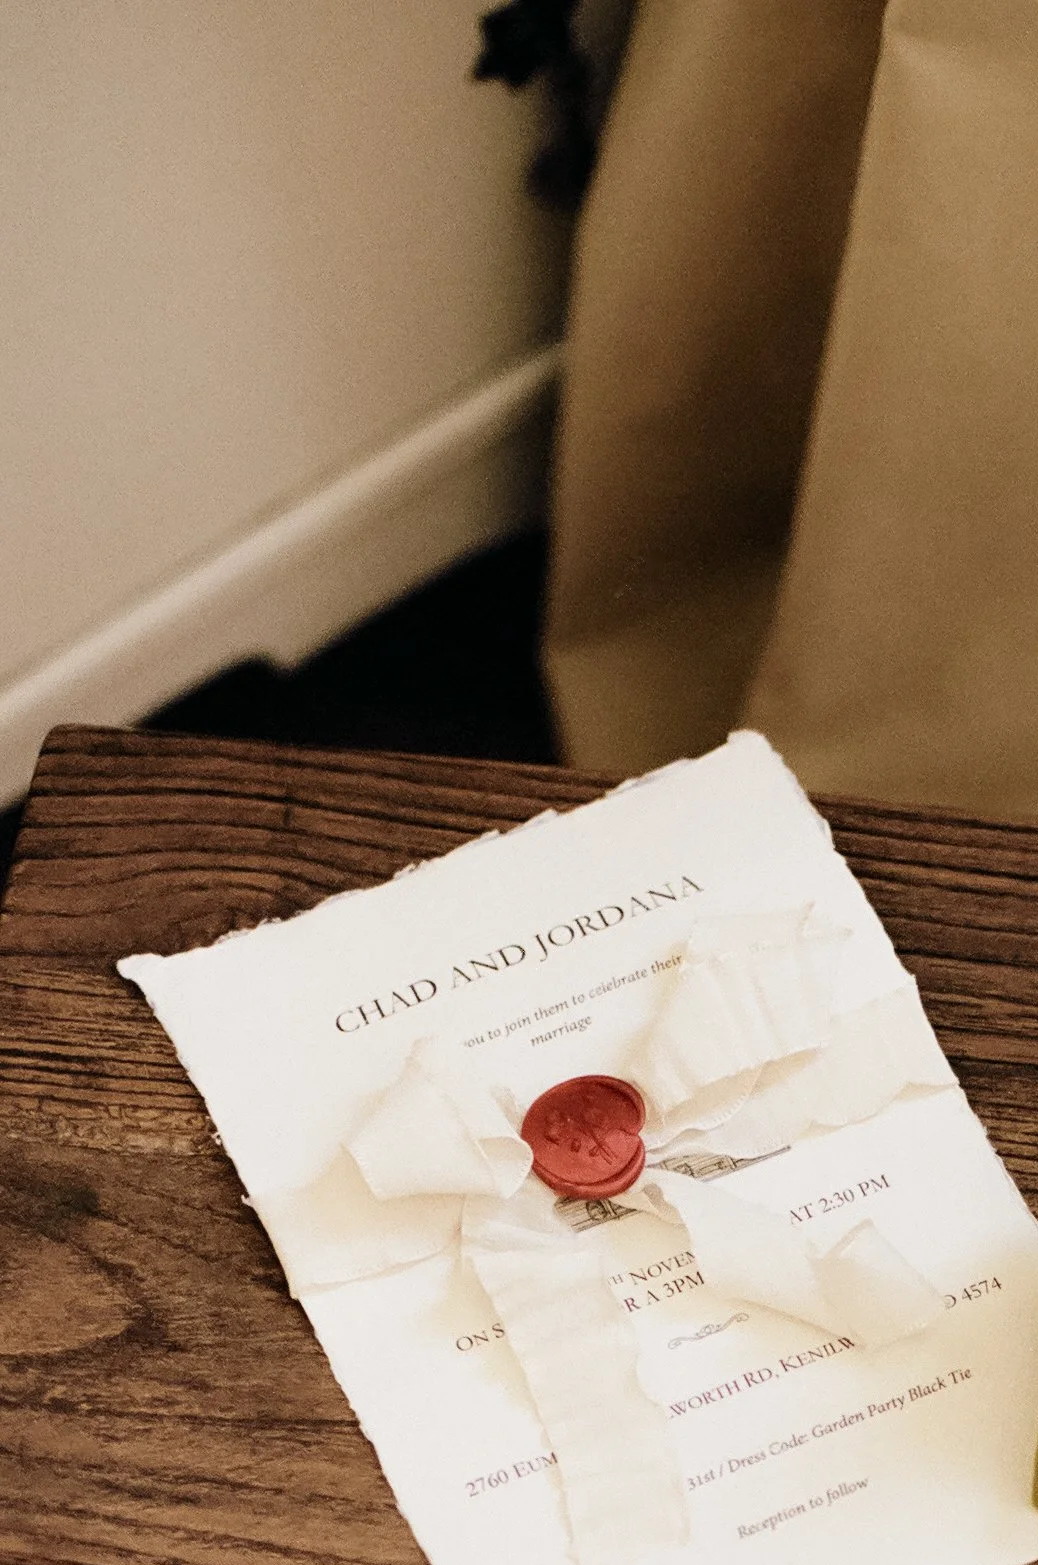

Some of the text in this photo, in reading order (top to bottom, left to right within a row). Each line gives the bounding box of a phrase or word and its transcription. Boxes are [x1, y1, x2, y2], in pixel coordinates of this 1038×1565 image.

[335, 874, 705, 1033] CHAD AND JORDANA
[463, 954, 683, 1048] ou to join them to celebrate their
[531, 1015, 592, 1047] marriage
[456, 1330, 489, 1351] ON
[790, 1203, 814, 1225] AT
[818, 1188, 855, 1214] 2:30
[859, 1174, 890, 1197] PM
[663, 1271, 705, 1298] 3PM
[465, 1469, 509, 1497] 2760
[513, 1452, 558, 1478] EUM
[668, 1380, 741, 1418] WORTH
[743, 1367, 780, 1388] RD,
[779, 1336, 856, 1372] KENILW
[961, 1276, 1003, 1301] 4574
[728, 1452, 767, 1474] Dress
[811, 1412, 865, 1438] Garden
[867, 1395, 906, 1418] Party
[908, 1378, 947, 1402] Black
[948, 1367, 973, 1385] Tie
[737, 1477, 869, 1540] Reception to follow
